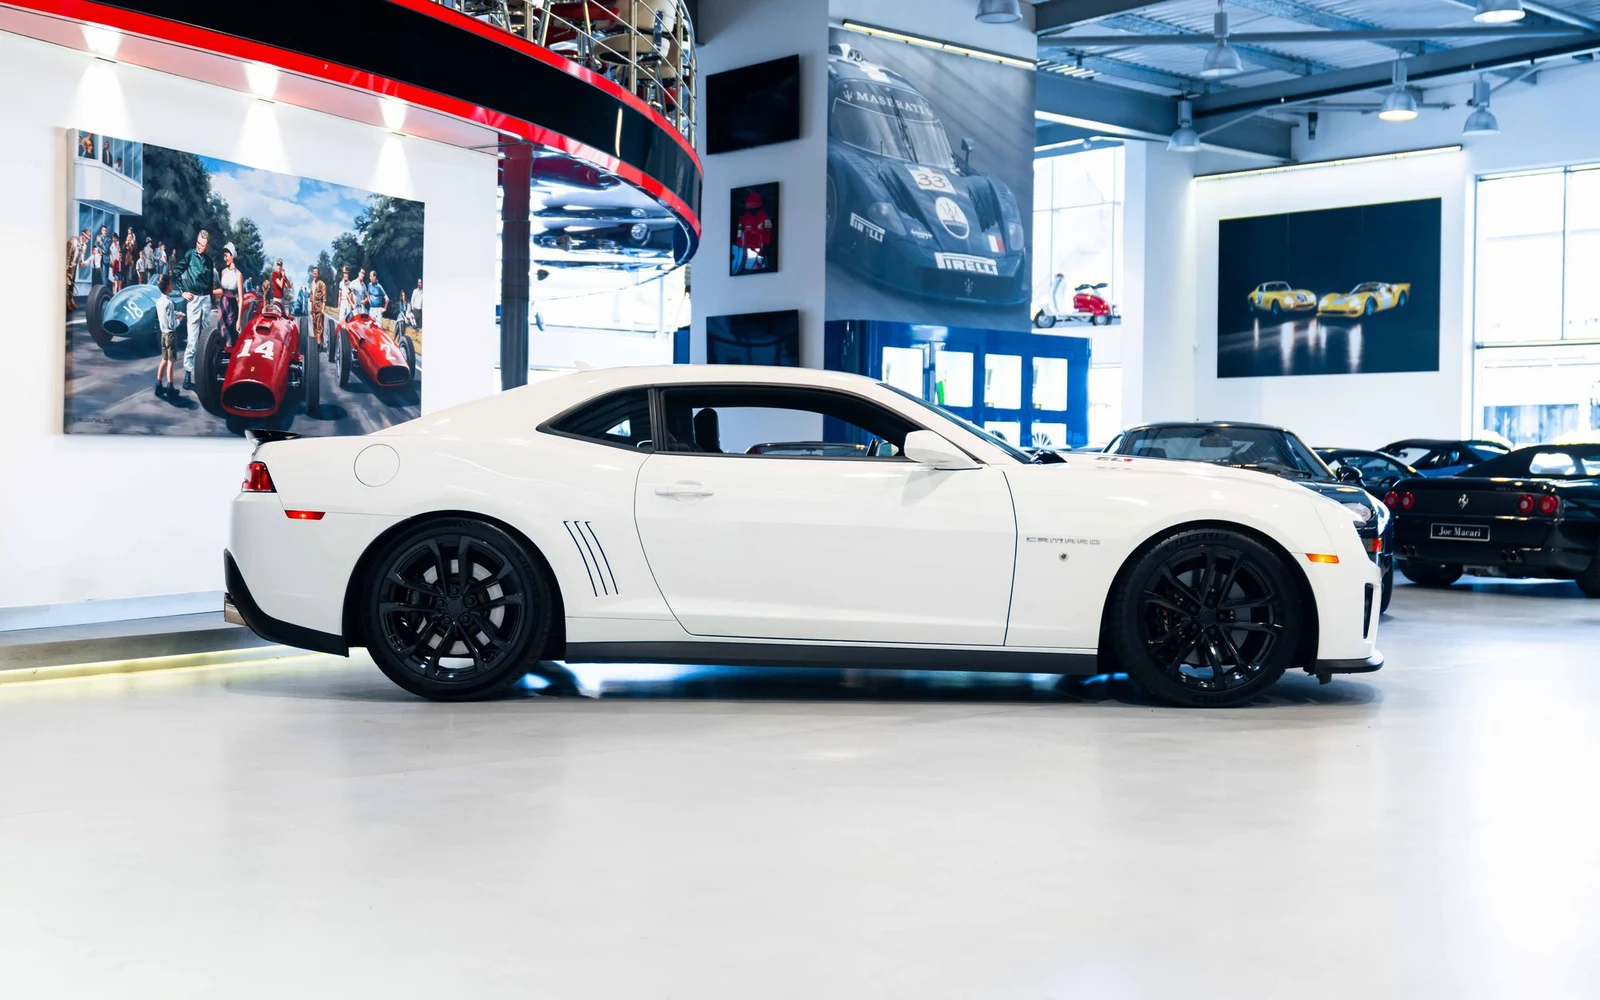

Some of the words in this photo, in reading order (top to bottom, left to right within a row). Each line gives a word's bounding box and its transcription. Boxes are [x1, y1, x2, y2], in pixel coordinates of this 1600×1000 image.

[917, 174, 946, 188] 33
[934, 251, 999, 276] PIRELLI
[123, 301, 145, 321] 18
[237, 338, 275, 360] 14
[1438, 526, 1452, 536] Joe
[1454, 527, 1481, 538] Macari
[1026, 537, 1101, 545] CAMARO
